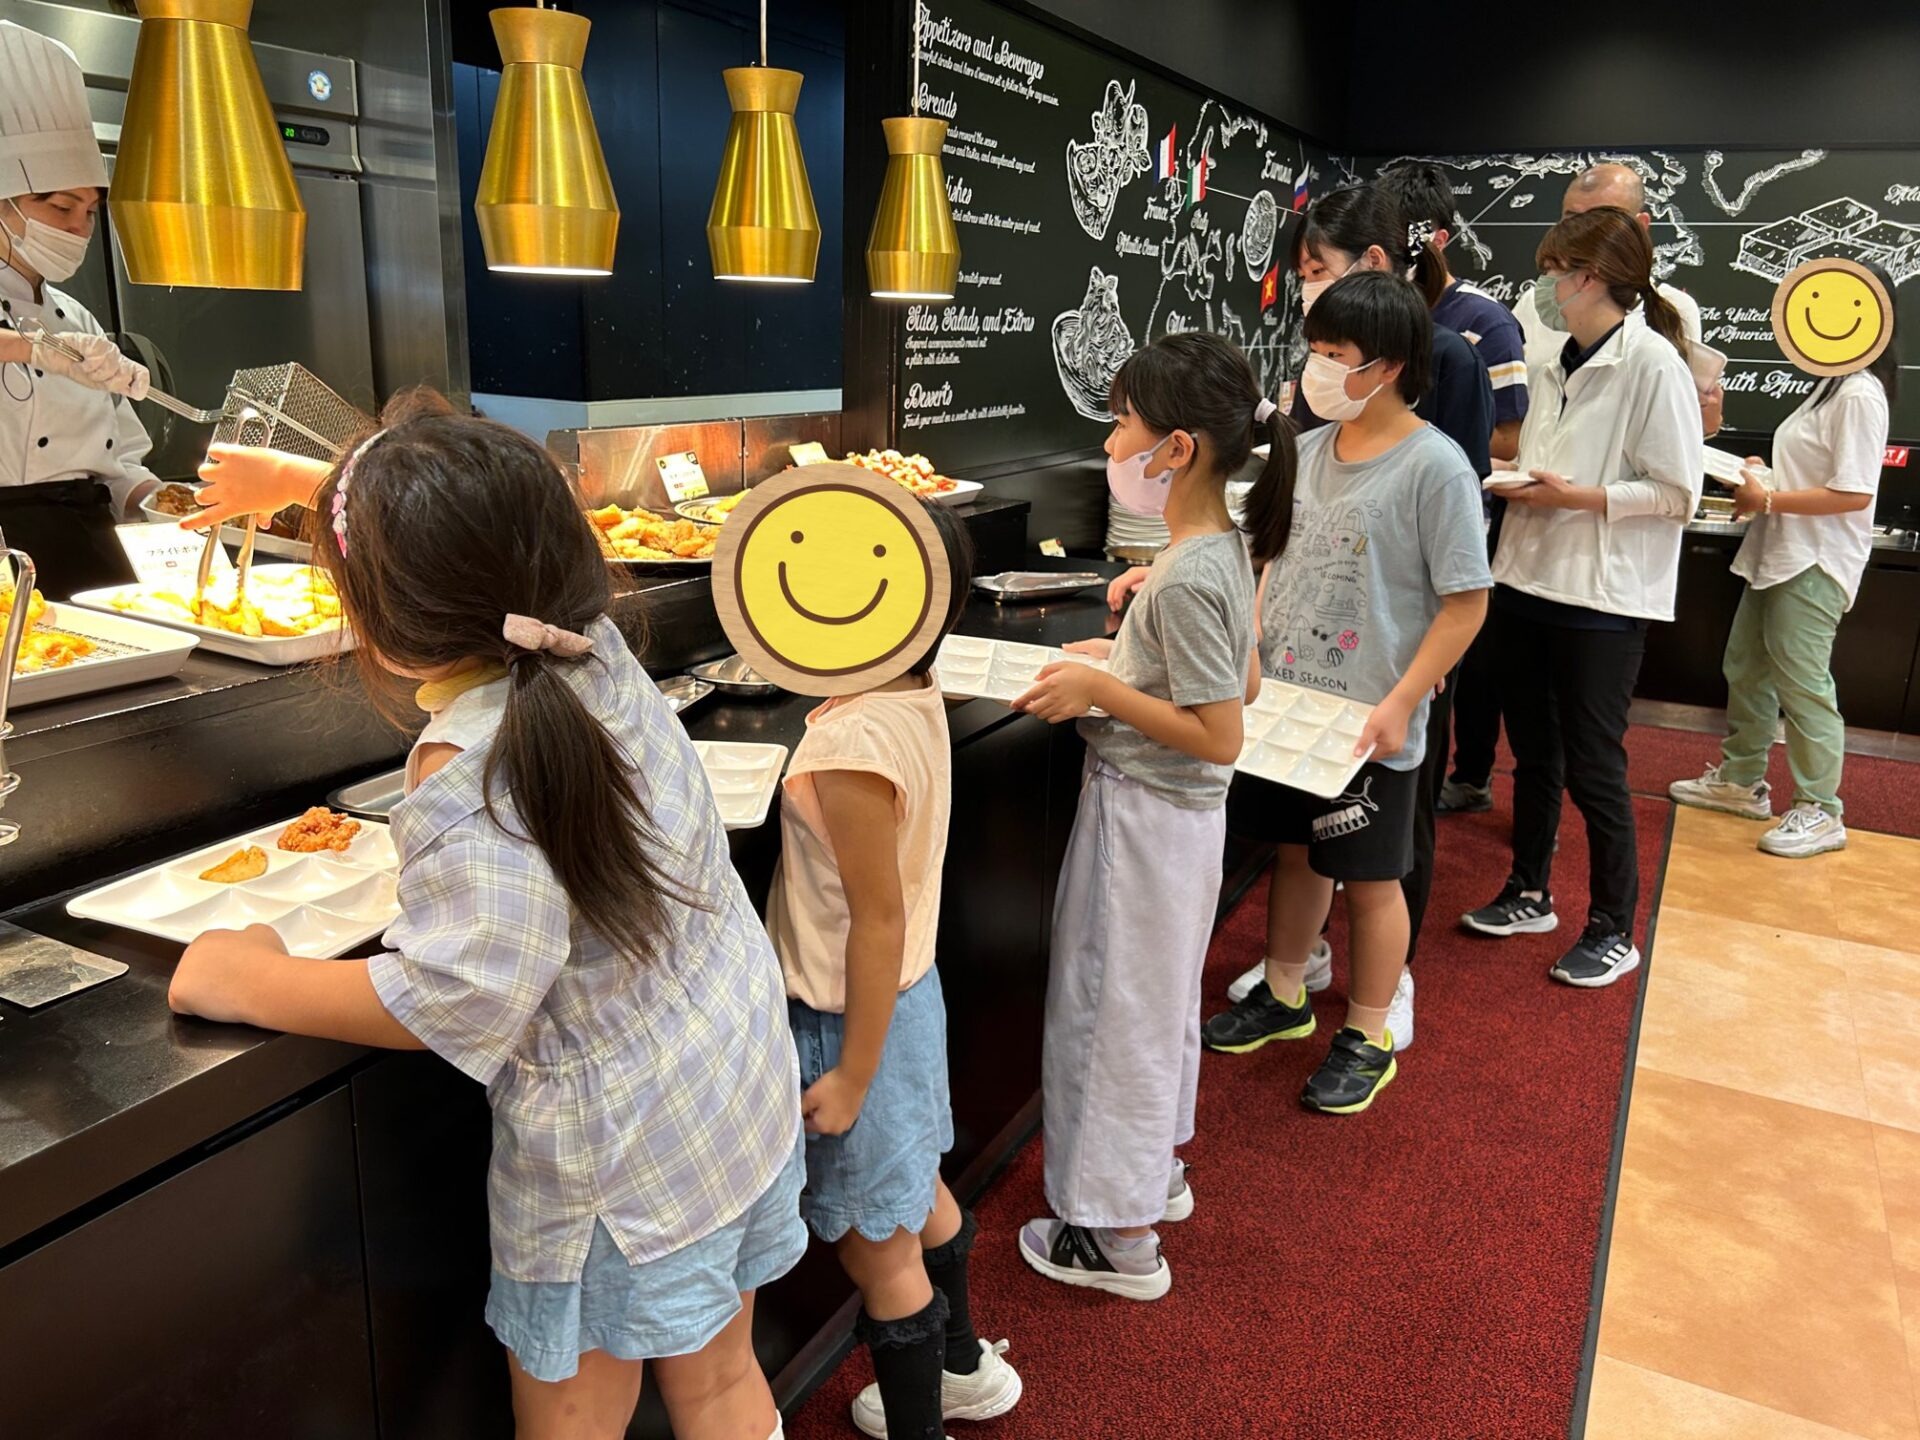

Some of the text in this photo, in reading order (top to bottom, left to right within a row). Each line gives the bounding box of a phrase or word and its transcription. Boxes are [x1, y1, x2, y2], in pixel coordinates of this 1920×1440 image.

[913, 2, 1045, 85] Appetizers and Beverages
[912, 82, 957, 119] Breads
[946, 175, 973, 206] ishes
[1450, 180, 1473, 195] ada
[906, 304, 1035, 335] Sides, Salads, and Extras
[1700, 306, 1721, 321] The
[1725, 306, 1770, 324] United
[1703, 324, 1775, 344] of America
[904, 381, 953, 410] Desserts
[1299, 671, 1347, 691] SEASON
